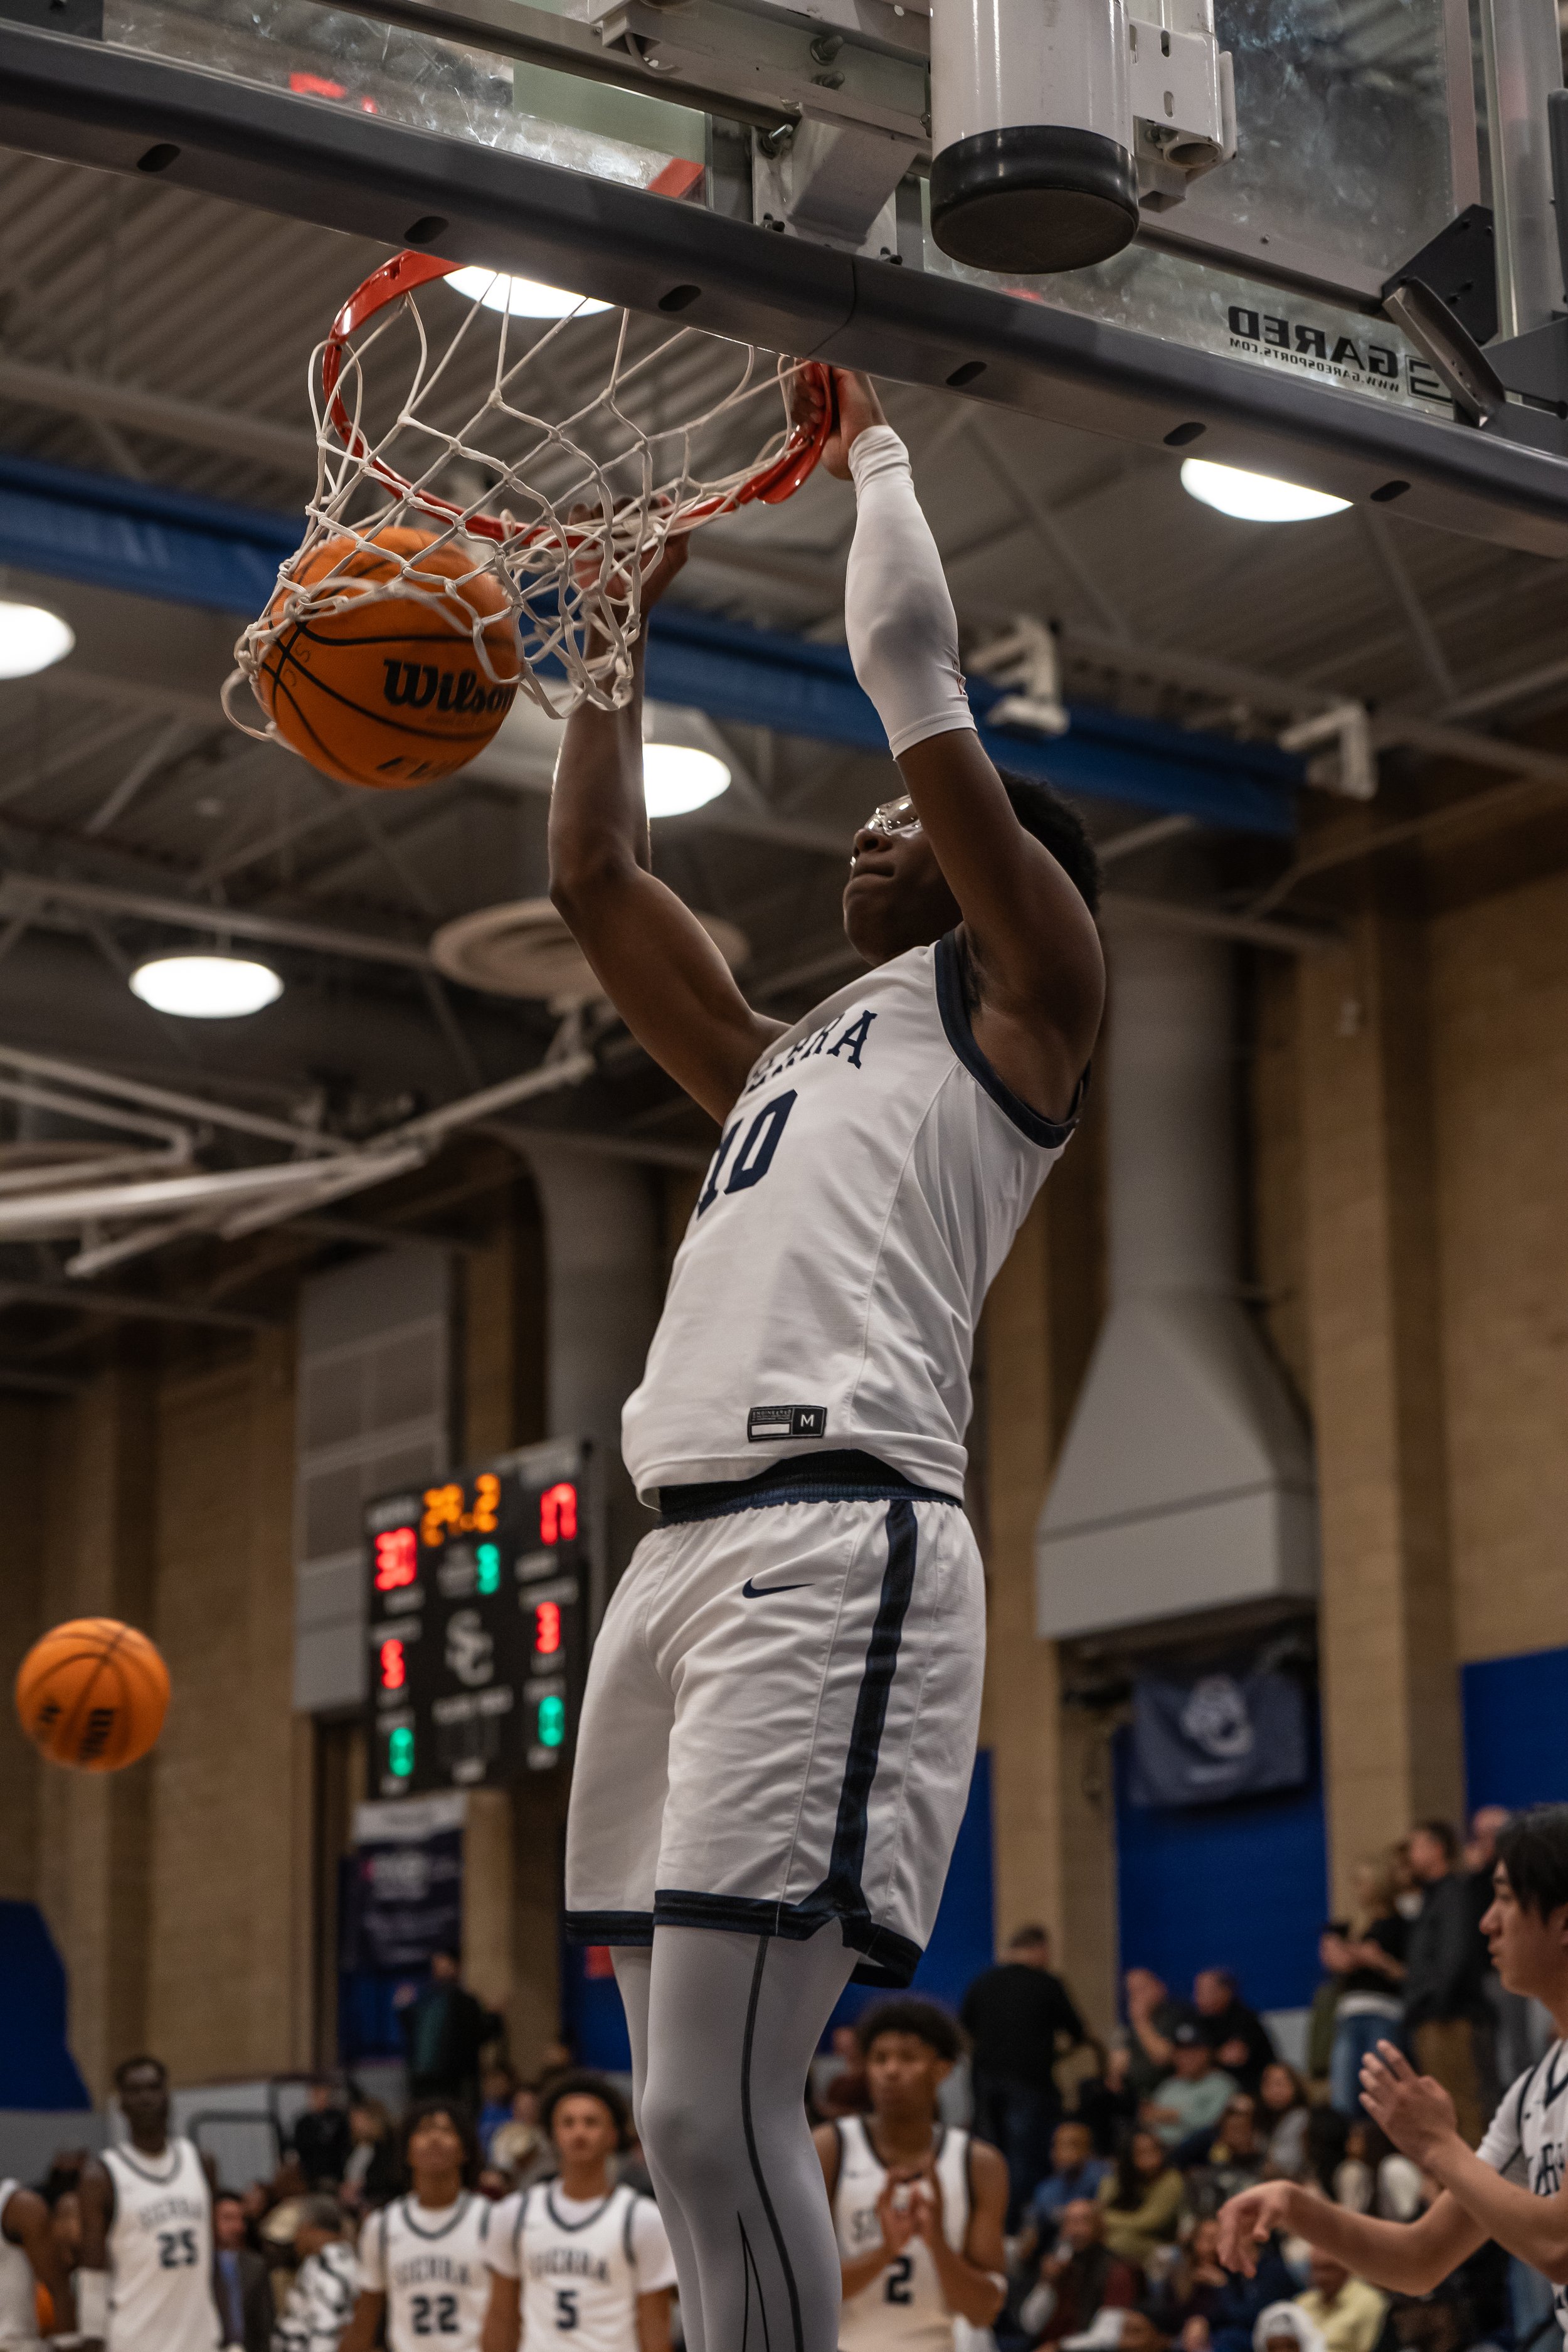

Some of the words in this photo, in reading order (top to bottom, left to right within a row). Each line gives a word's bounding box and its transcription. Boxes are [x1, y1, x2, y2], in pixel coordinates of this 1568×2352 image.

[697, 1088, 798, 1221] 10
[800, 1414, 814, 1428] M
[157, 2227, 198, 2269] 25
[885, 2255, 914, 2305] 2
[411, 2294, 460, 2336] 22
[556, 2290, 578, 2331] 5
